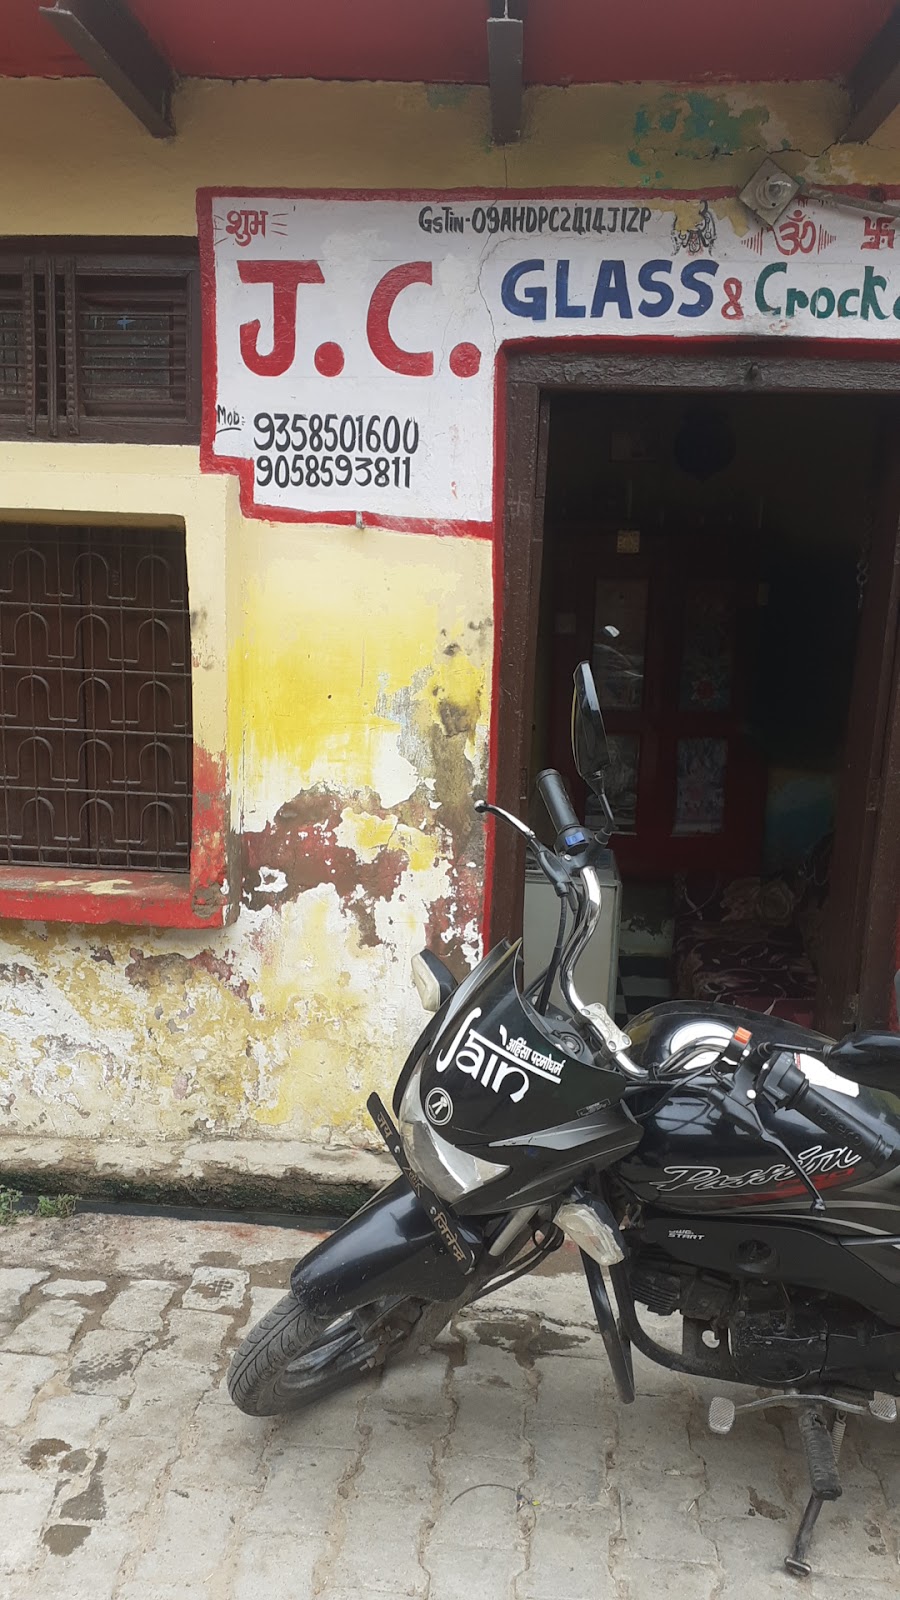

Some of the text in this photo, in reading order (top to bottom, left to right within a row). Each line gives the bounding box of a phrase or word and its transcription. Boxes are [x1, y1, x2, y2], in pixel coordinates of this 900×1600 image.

[226, 210, 268, 246] शुभ
[501, 259, 719, 321] GLASS
[721, 277, 743, 320] &
[253, 412, 419, 454] 9358501600
[256, 455, 411, 488] 9058593811
[667, 1233, 705, 1241] START
